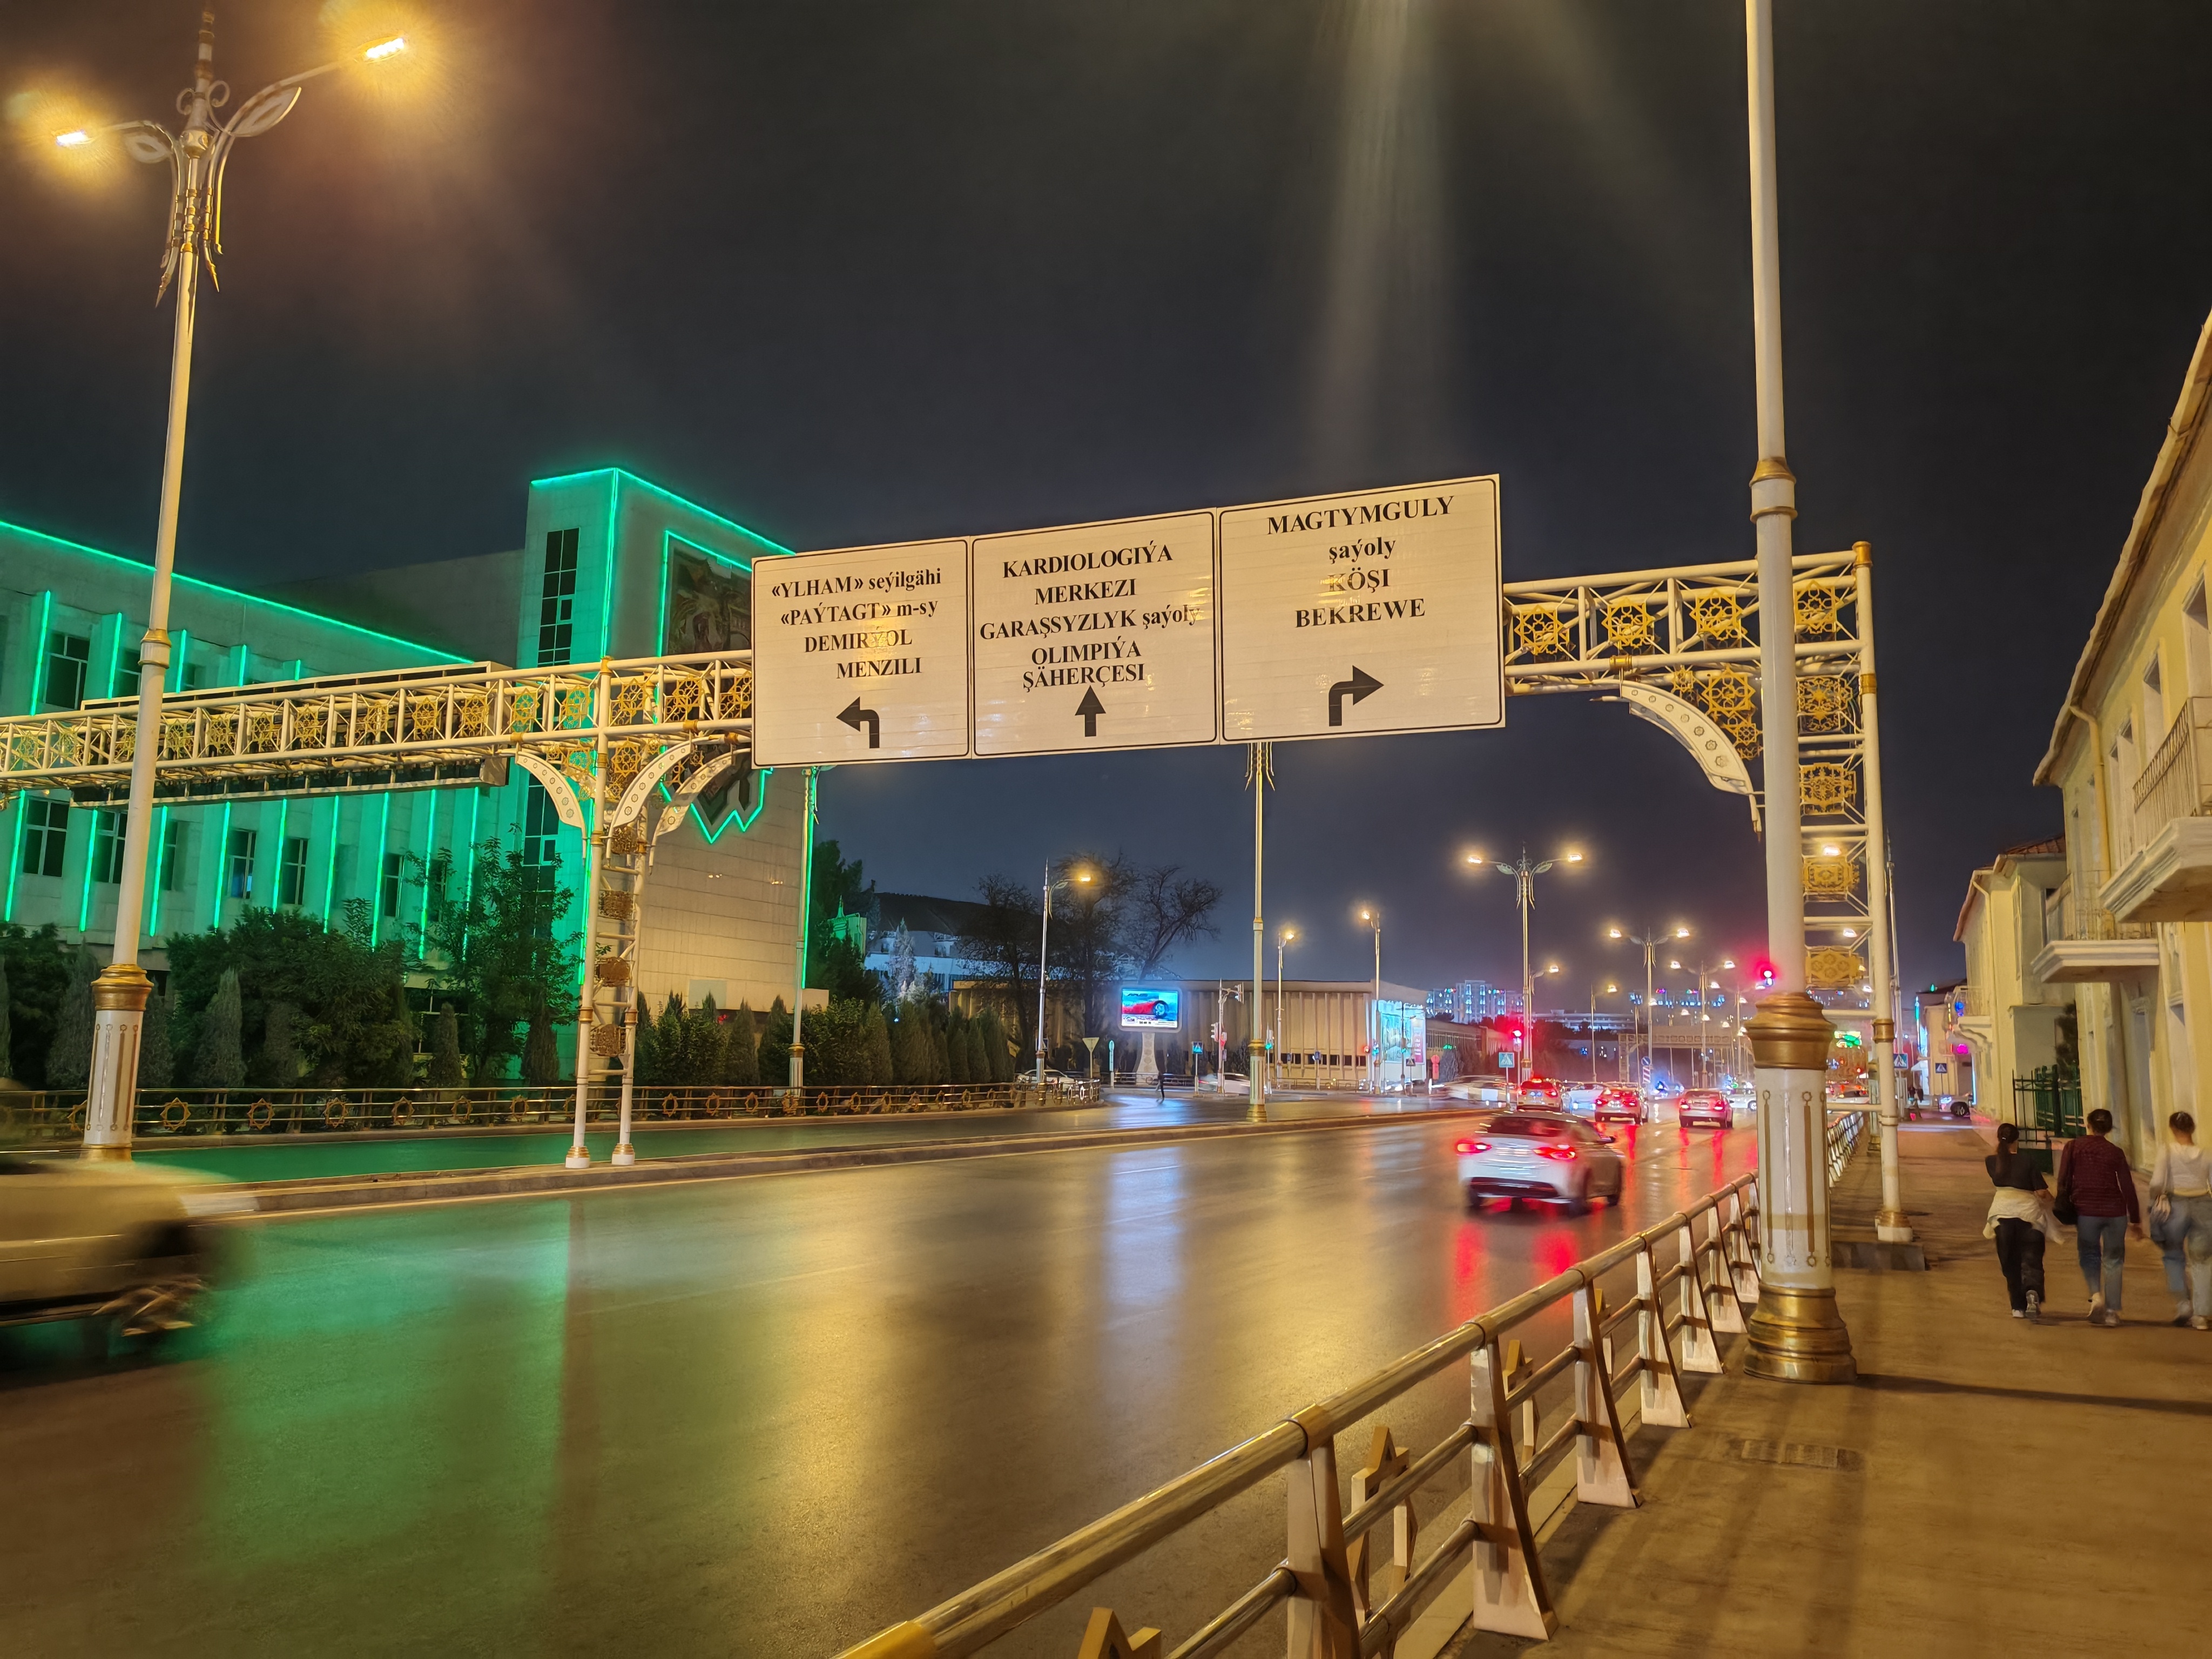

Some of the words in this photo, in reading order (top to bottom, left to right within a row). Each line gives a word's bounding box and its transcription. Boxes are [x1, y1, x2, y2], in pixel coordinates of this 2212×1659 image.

[1267, 496, 1454, 535] MAGTYMGULY
[1003, 540, 1173, 578] KARDIOLOGIÝA
[1328, 537, 1396, 564] şaýoly
[772, 576, 864, 597] «YLHAM»
[868, 568, 941, 593] seýilgähi
[1034, 578, 1137, 605] MERKEZI
[1328, 567, 1391, 593] KÖŞI
[780, 602, 891, 625] «PAÝTAGT»
[897, 601, 939, 617] m-sy
[980, 610, 1137, 639] GARAŞSYZLYK
[1142, 605, 1200, 630] şaýoly
[1295, 598, 1426, 628] BEKREWE
[804, 626, 912, 652] DEMIRÝOL
[1031, 636, 1142, 665] OLIMPIÝA
[836, 657, 922, 679] MENZILI
[1023, 663, 1145, 692] ŞÄHERÇESI
